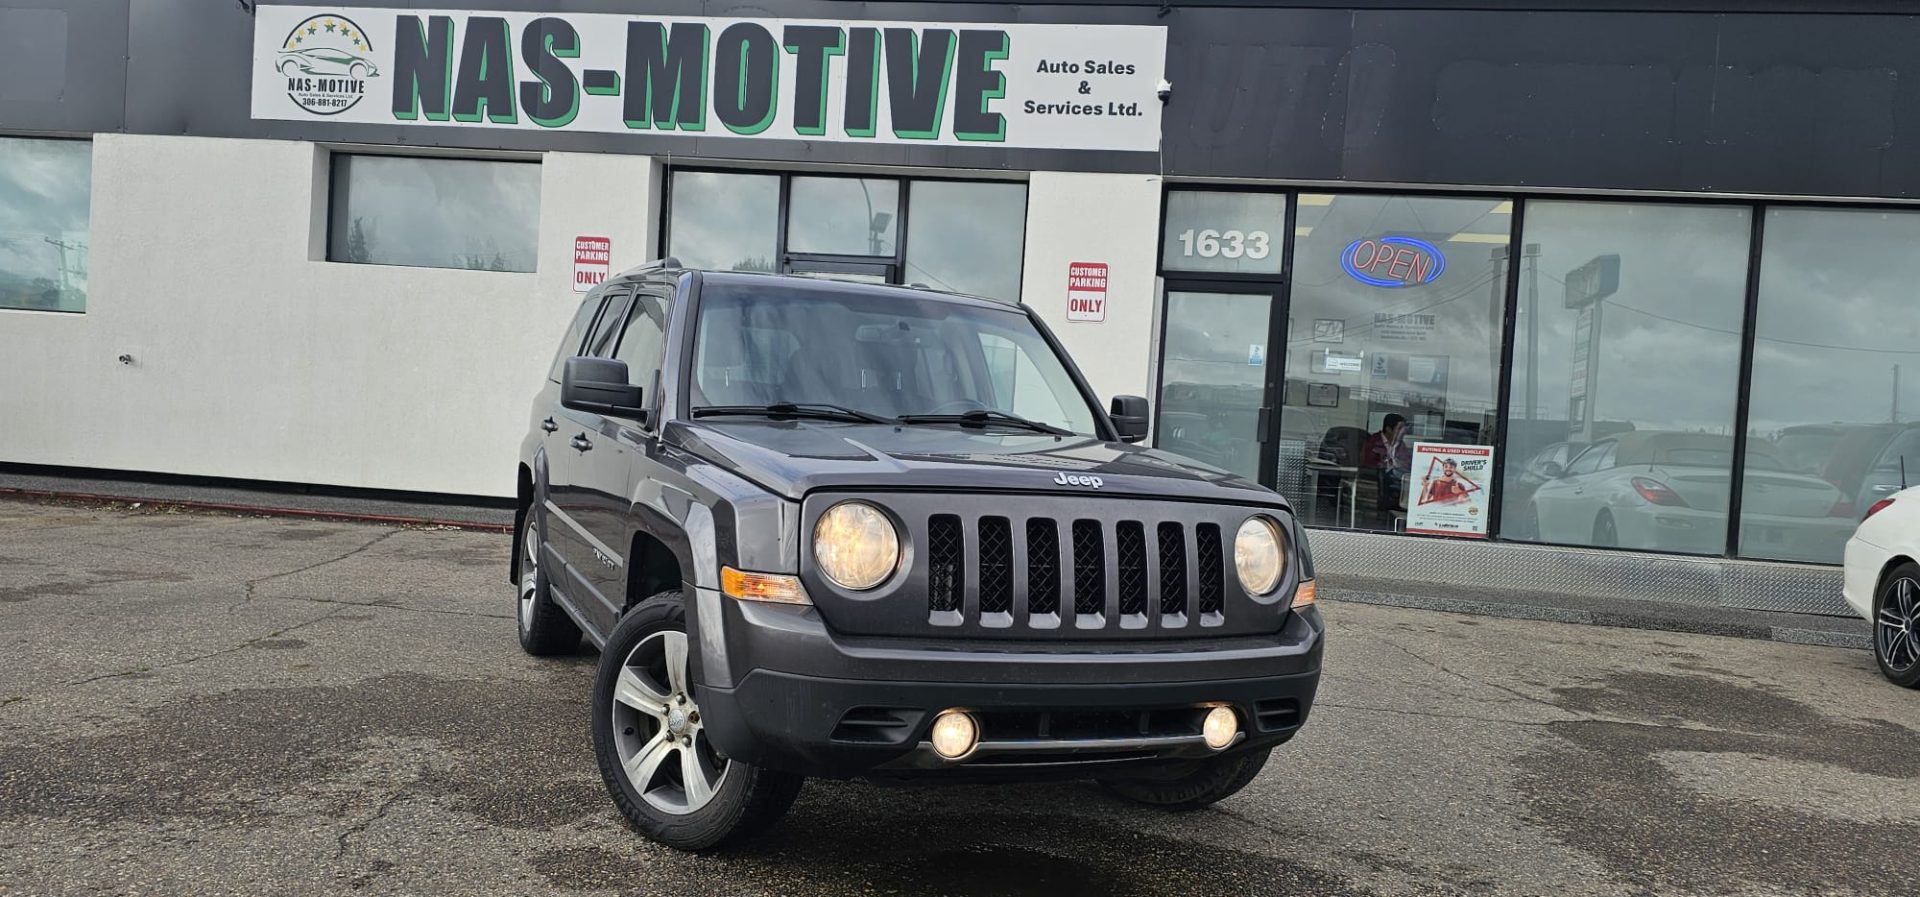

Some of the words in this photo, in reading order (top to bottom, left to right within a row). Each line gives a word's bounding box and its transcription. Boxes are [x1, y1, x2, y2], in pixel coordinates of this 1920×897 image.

[1036, 59, 1080, 74] Auto
[1084, 60, 1136, 75] Sales
[288, 78, 364, 93] NAS-MOTIVE
[393, 15, 1010, 142] NAS-MOTIVE
[1078, 80, 1092, 95] &
[1024, 100, 1104, 116] Services
[1108, 102, 1143, 117] Ltd.
[576, 240, 609, 250] CUSTOMER
[1179, 229, 1270, 260] 1633
[575, 250, 609, 261] PARKING
[1353, 240, 1432, 284] OPEN
[576, 271, 606, 285] ONLY
[1070, 266, 1107, 277] CUSTOMER
[1070, 277, 1106, 288] PARKING
[1070, 298, 1102, 313] ONLY
[1053, 471, 1104, 489] Jeep
